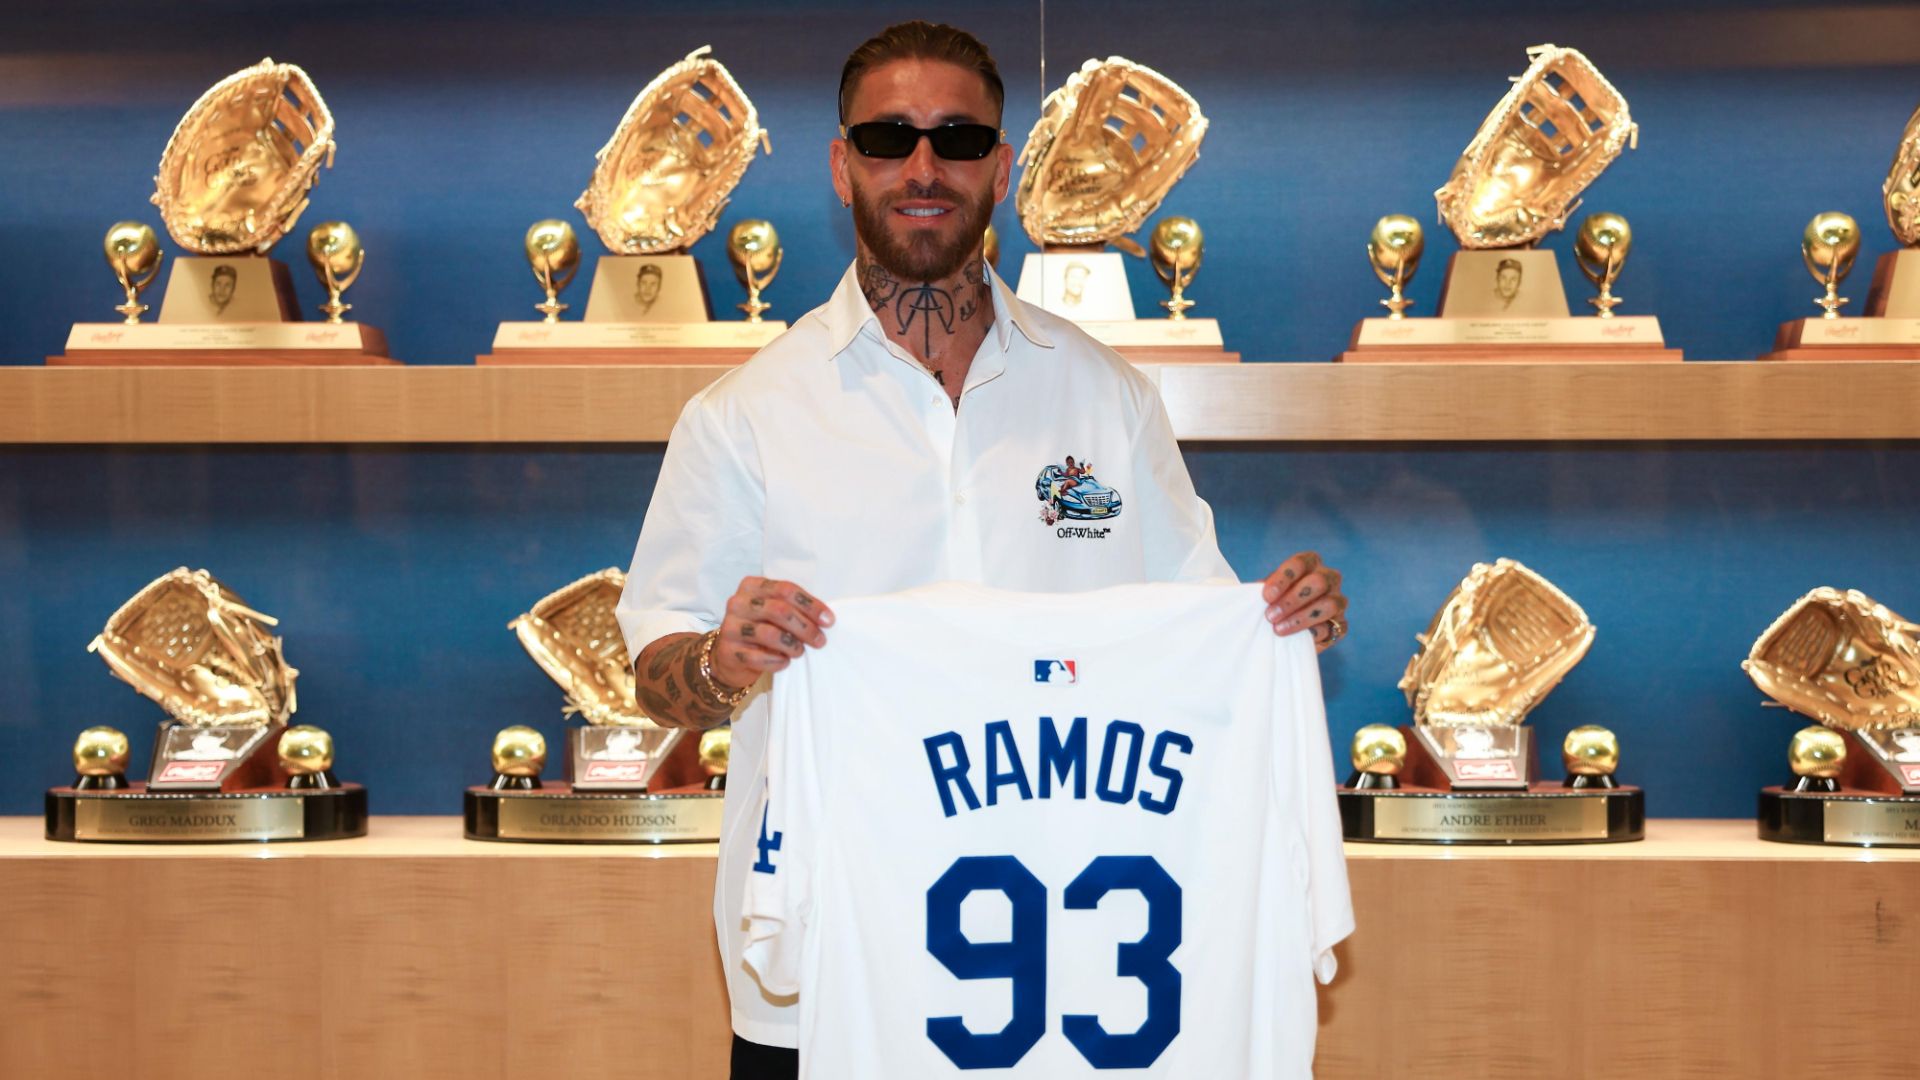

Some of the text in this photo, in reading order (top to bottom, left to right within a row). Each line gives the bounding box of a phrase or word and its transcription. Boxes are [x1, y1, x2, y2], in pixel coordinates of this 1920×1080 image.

[923, 716, 1194, 818] RAMOS
[129, 815, 236, 826] GREG MADDUX
[540, 814, 676, 826] ORLANDO HUDSON
[1440, 814, 1547, 826] ANDRE ETHIER
[926, 855, 1182, 1070] 93
